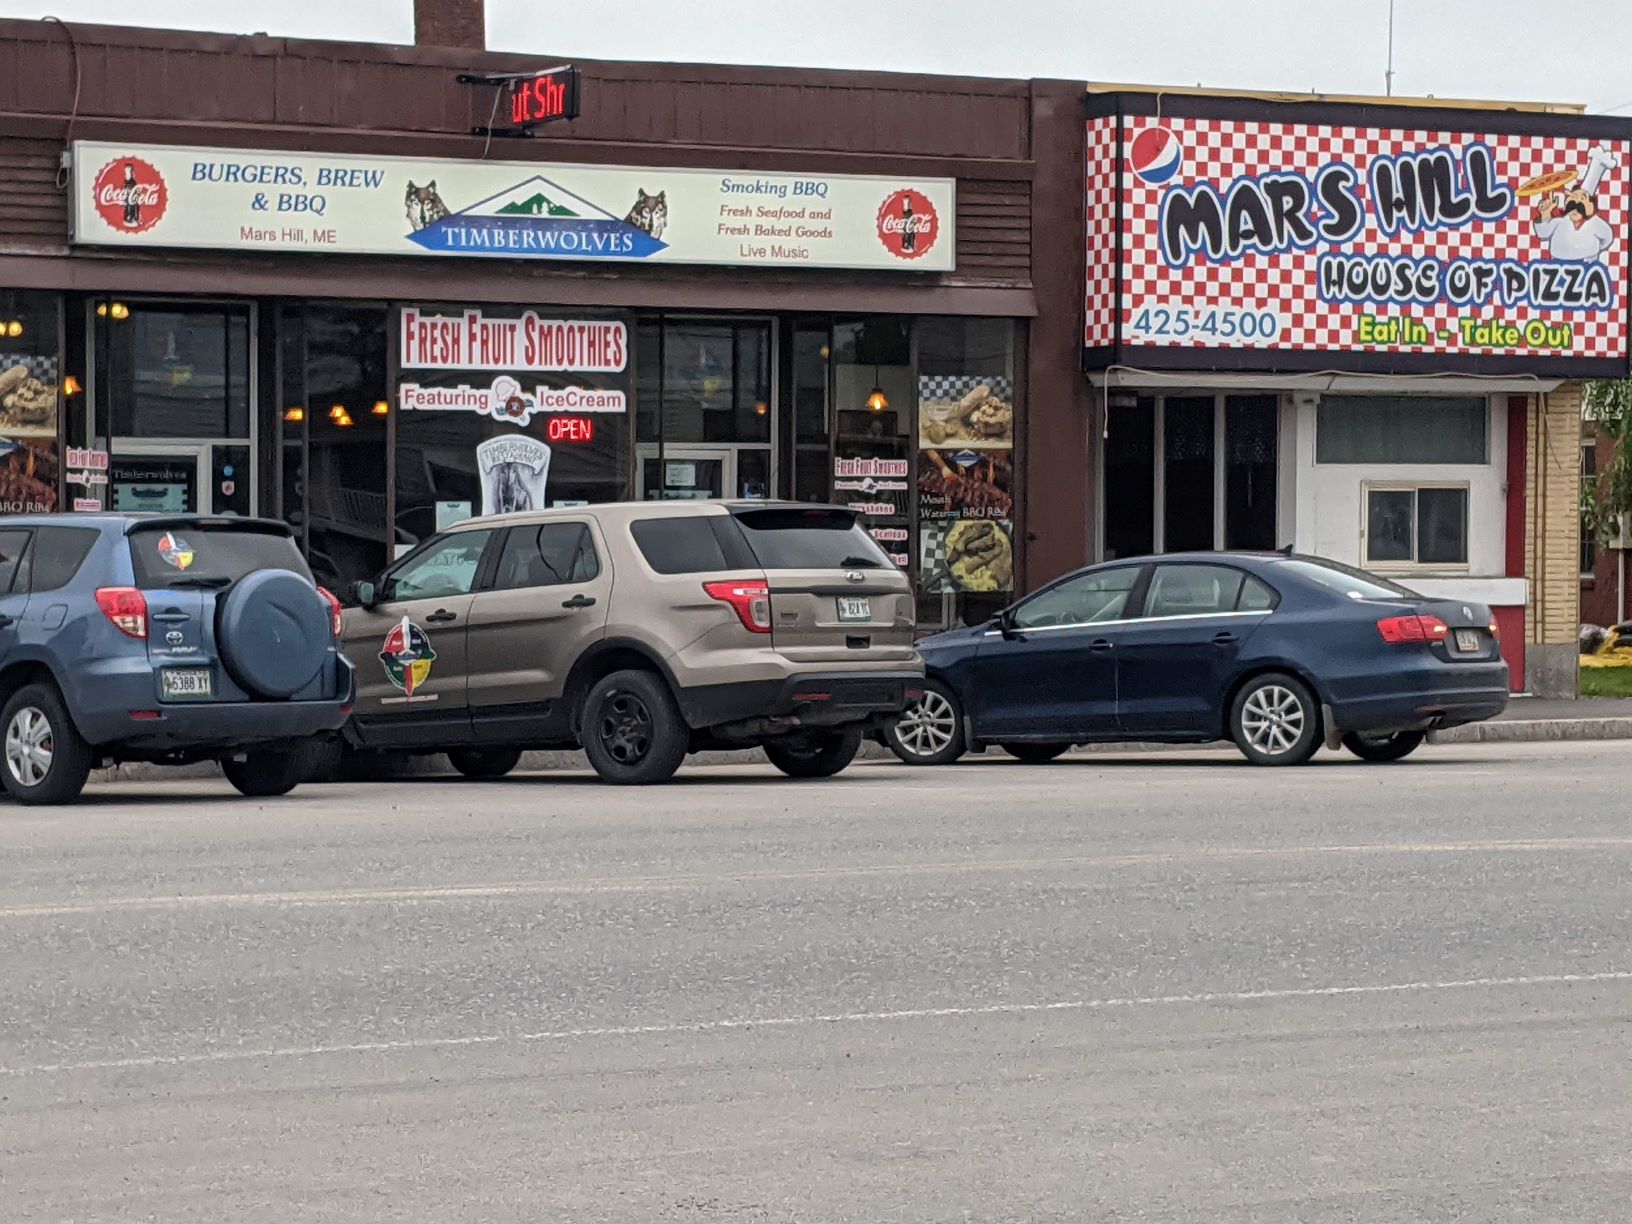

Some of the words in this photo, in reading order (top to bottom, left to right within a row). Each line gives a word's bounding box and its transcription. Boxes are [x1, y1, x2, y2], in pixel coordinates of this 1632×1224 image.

[191, 162, 308, 188] BURGERS,
[317, 167, 385, 189] BREW
[719, 178, 787, 198] Smoking
[793, 181, 828, 199] BBQ
[251, 192, 269, 211] &
[276, 193, 327, 217] BBQ
[719, 204, 752, 218] Fresh
[756, 205, 805, 220] Seafood
[809, 208, 832, 220] and
[1162, 165, 1363, 264] MARS
[1372, 144, 1510, 233] HILL
[240, 226, 277, 242] Mars
[281, 227, 308, 244] Hill,
[313, 229, 337, 244] ME
[441, 226, 633, 252] TIMBERWOLVES
[717, 223, 750, 236] Fresh
[754, 224, 792, 237] Baked
[795, 226, 833, 239] Goods
[739, 243, 767, 258] Live
[770, 245, 809, 259] Music
[1320, 254, 1439, 299] HOUSE
[1445, 258, 1496, 304] OF
[1499, 259, 1611, 308] PIZZA
[1133, 308, 1277, 338] 425-4500
[1359, 315, 1400, 343] Eat
[1403, 317, 1427, 343] In
[1460, 319, 1520, 345] Take
[1525, 320, 1572, 347] Out
[404, 388, 489, 409] Featuring
[539, 390, 622, 408] IceCream
[547, 418, 593, 441] OPEN
